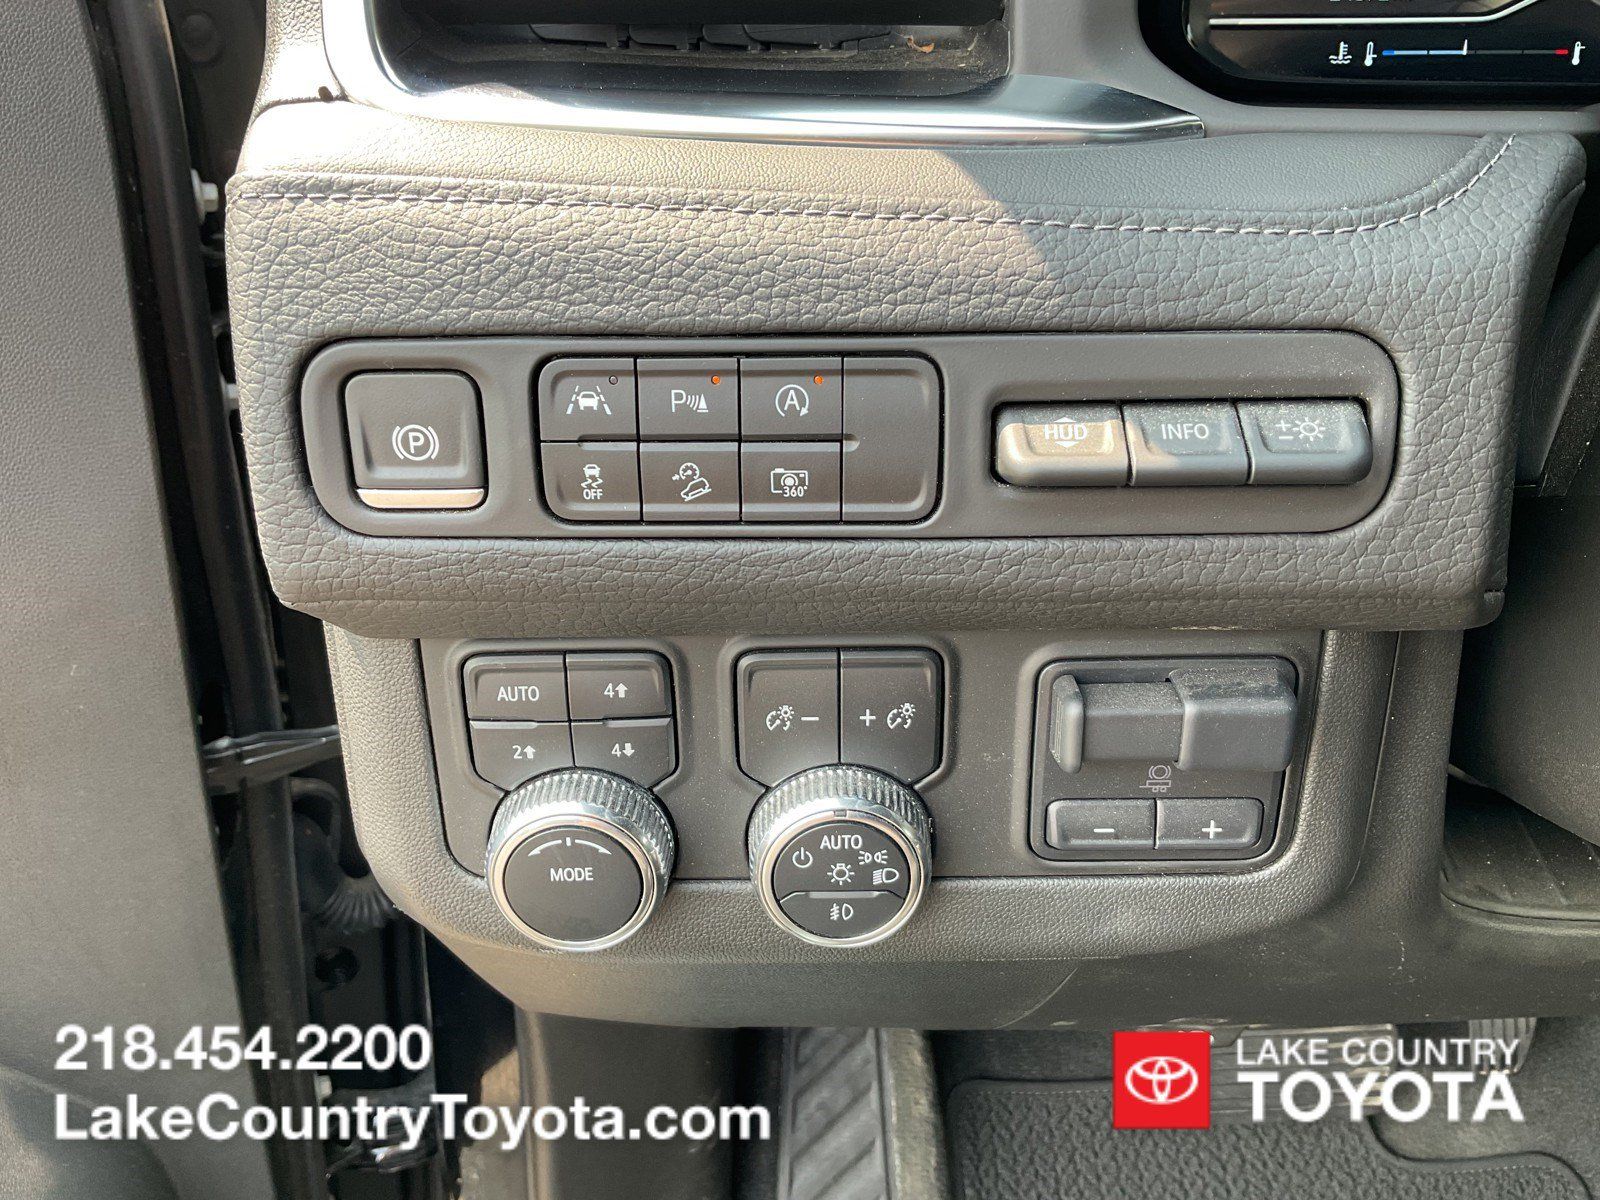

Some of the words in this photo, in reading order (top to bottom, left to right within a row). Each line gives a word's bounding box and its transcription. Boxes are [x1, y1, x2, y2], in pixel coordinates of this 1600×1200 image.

[1043, 424, 1088, 440] HUD
[1161, 423, 1210, 440] INFO
[582, 487, 604, 500] OFF
[497, 685, 540, 702] AUTO
[820, 834, 863, 850] AUTO
[550, 867, 594, 882] MODE
